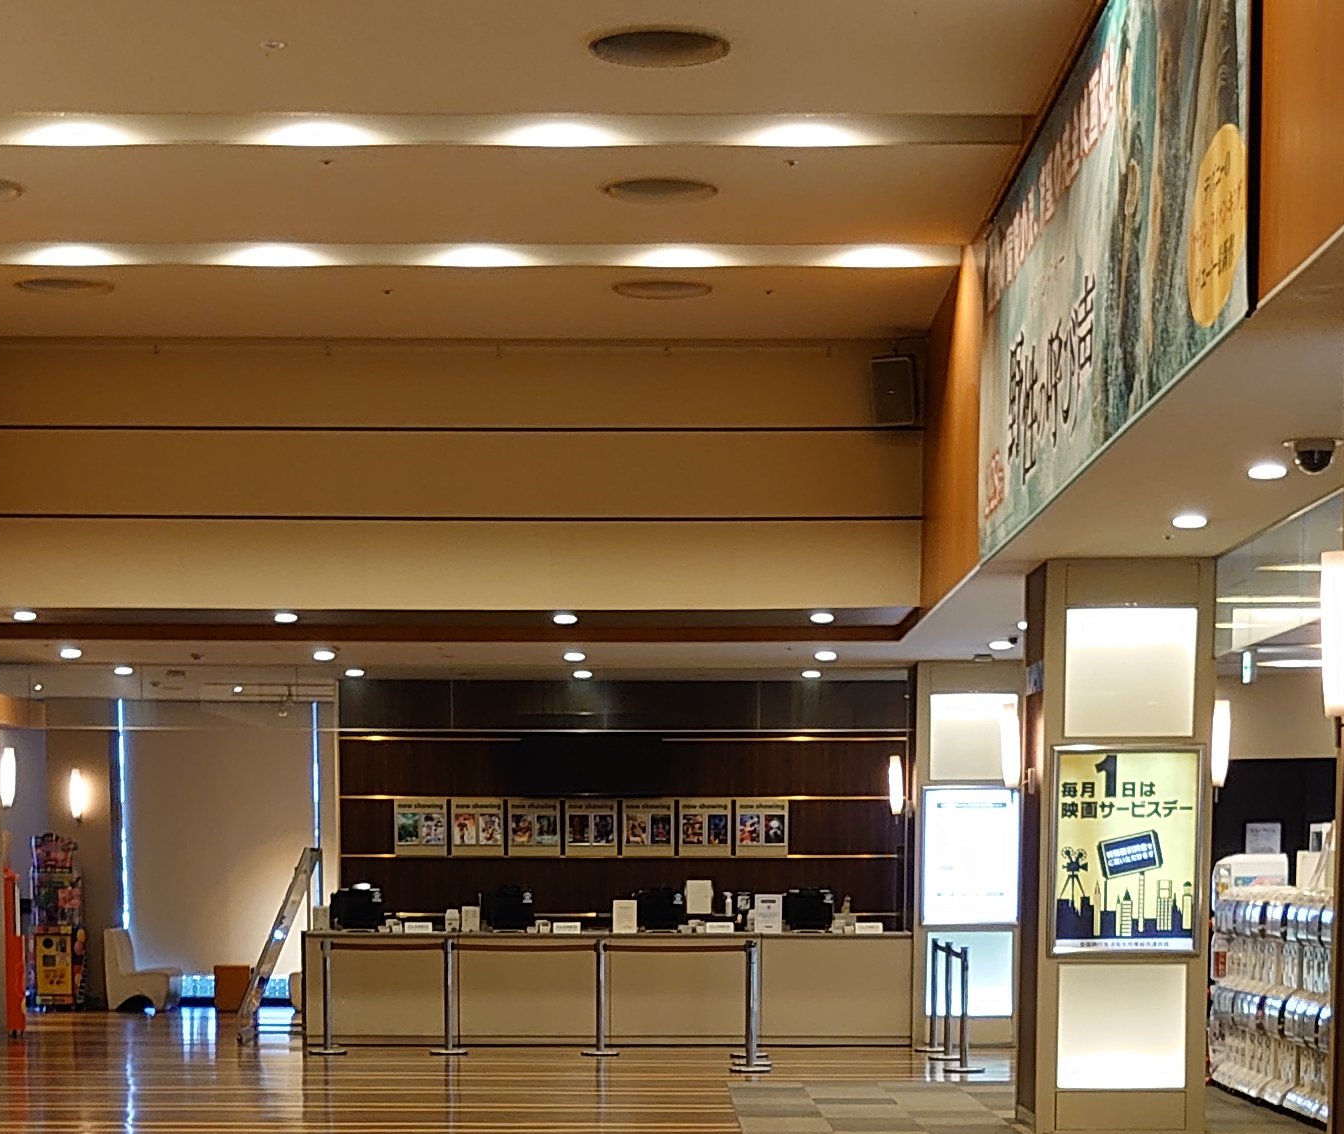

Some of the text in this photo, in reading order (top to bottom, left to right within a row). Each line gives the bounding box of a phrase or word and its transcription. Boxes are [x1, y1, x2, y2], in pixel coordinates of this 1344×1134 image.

[1061, 755, 1155, 798] 毎月1日は
[414, 802, 443, 810] showing
[473, 802, 501, 810] showing
[528, 802, 556, 810] showing
[585, 802, 614, 810] showing
[642, 802, 670, 810] showing
[699, 802, 727, 810] showing
[756, 802, 785, 810] showing
[1061, 800, 1193, 819] 映画サービスデー
